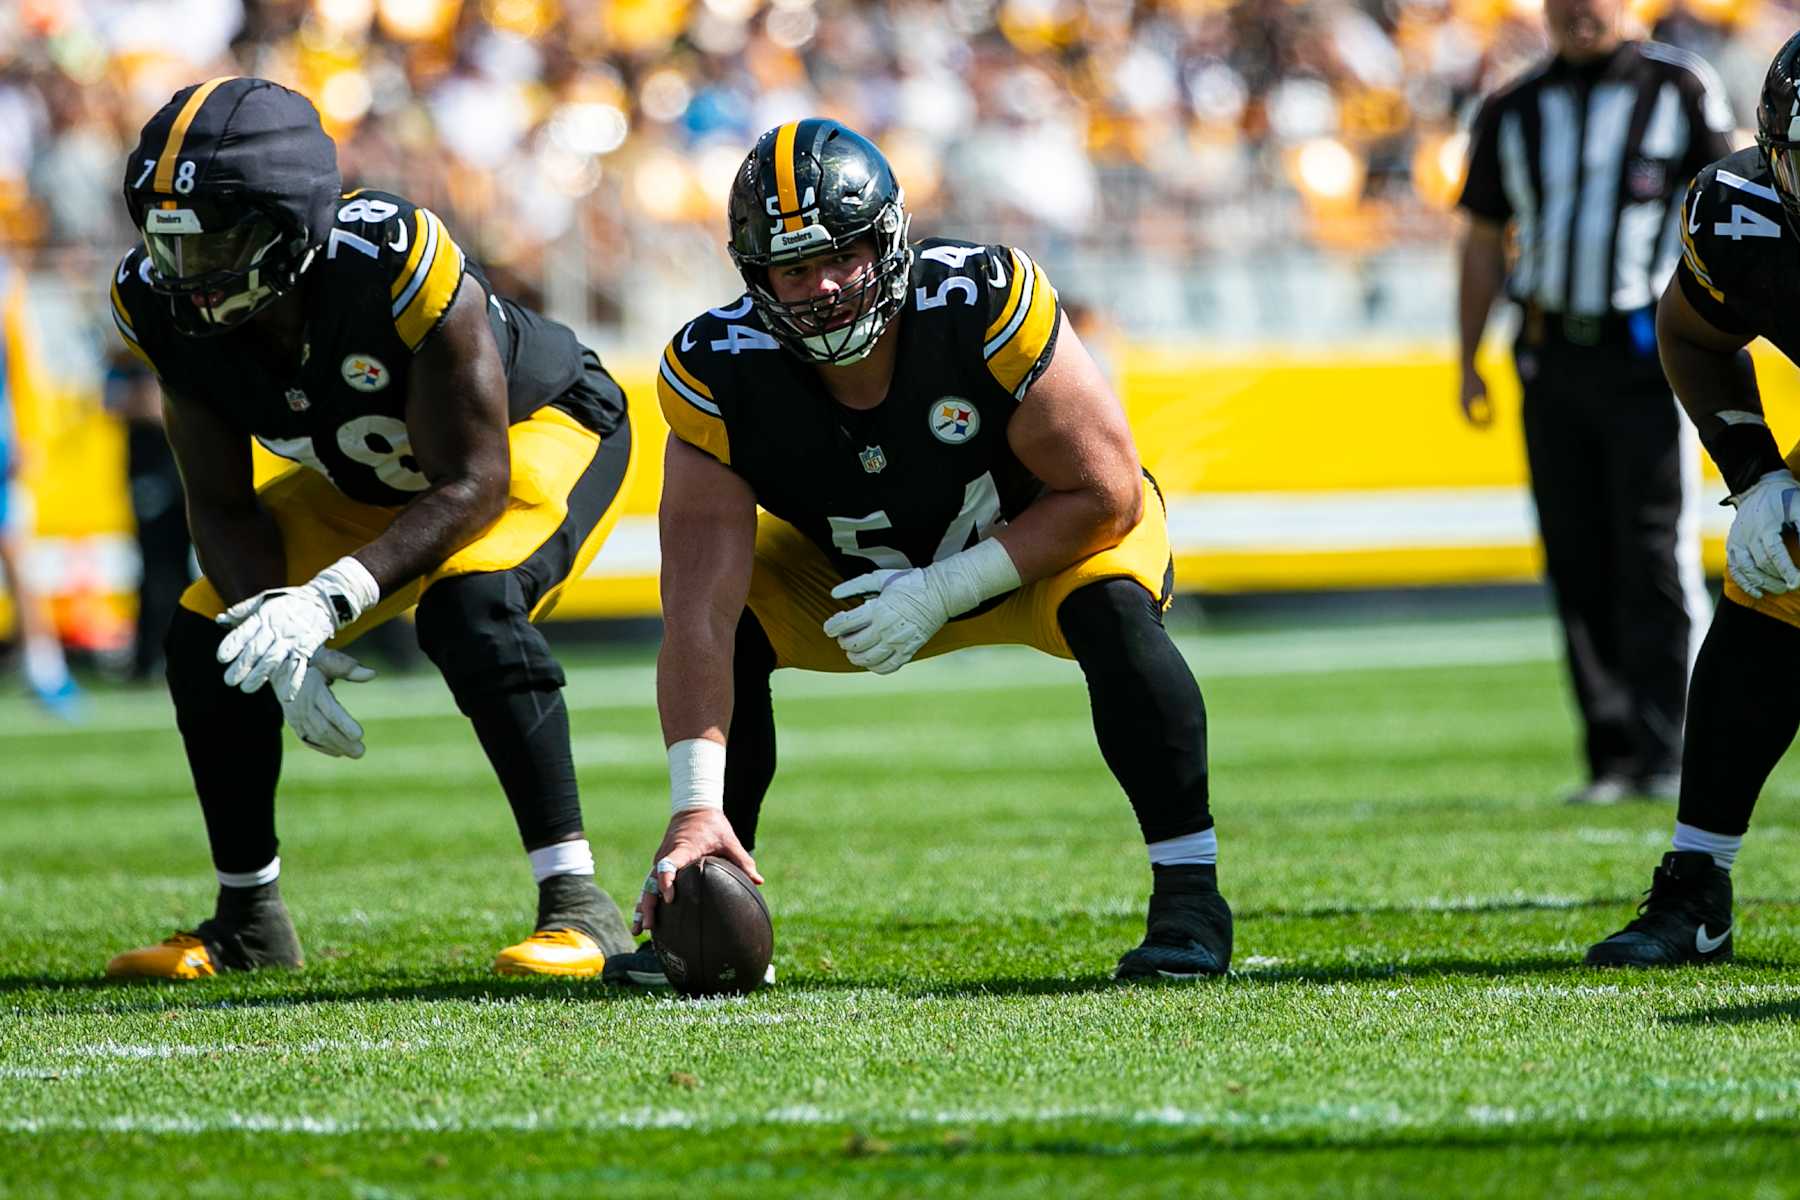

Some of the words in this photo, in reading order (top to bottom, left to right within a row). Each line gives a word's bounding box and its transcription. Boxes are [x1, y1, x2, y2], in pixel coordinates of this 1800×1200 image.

[327, 199, 398, 259] 78
[782, 232, 812, 246] Steelers
[916, 244, 986, 312] 54
